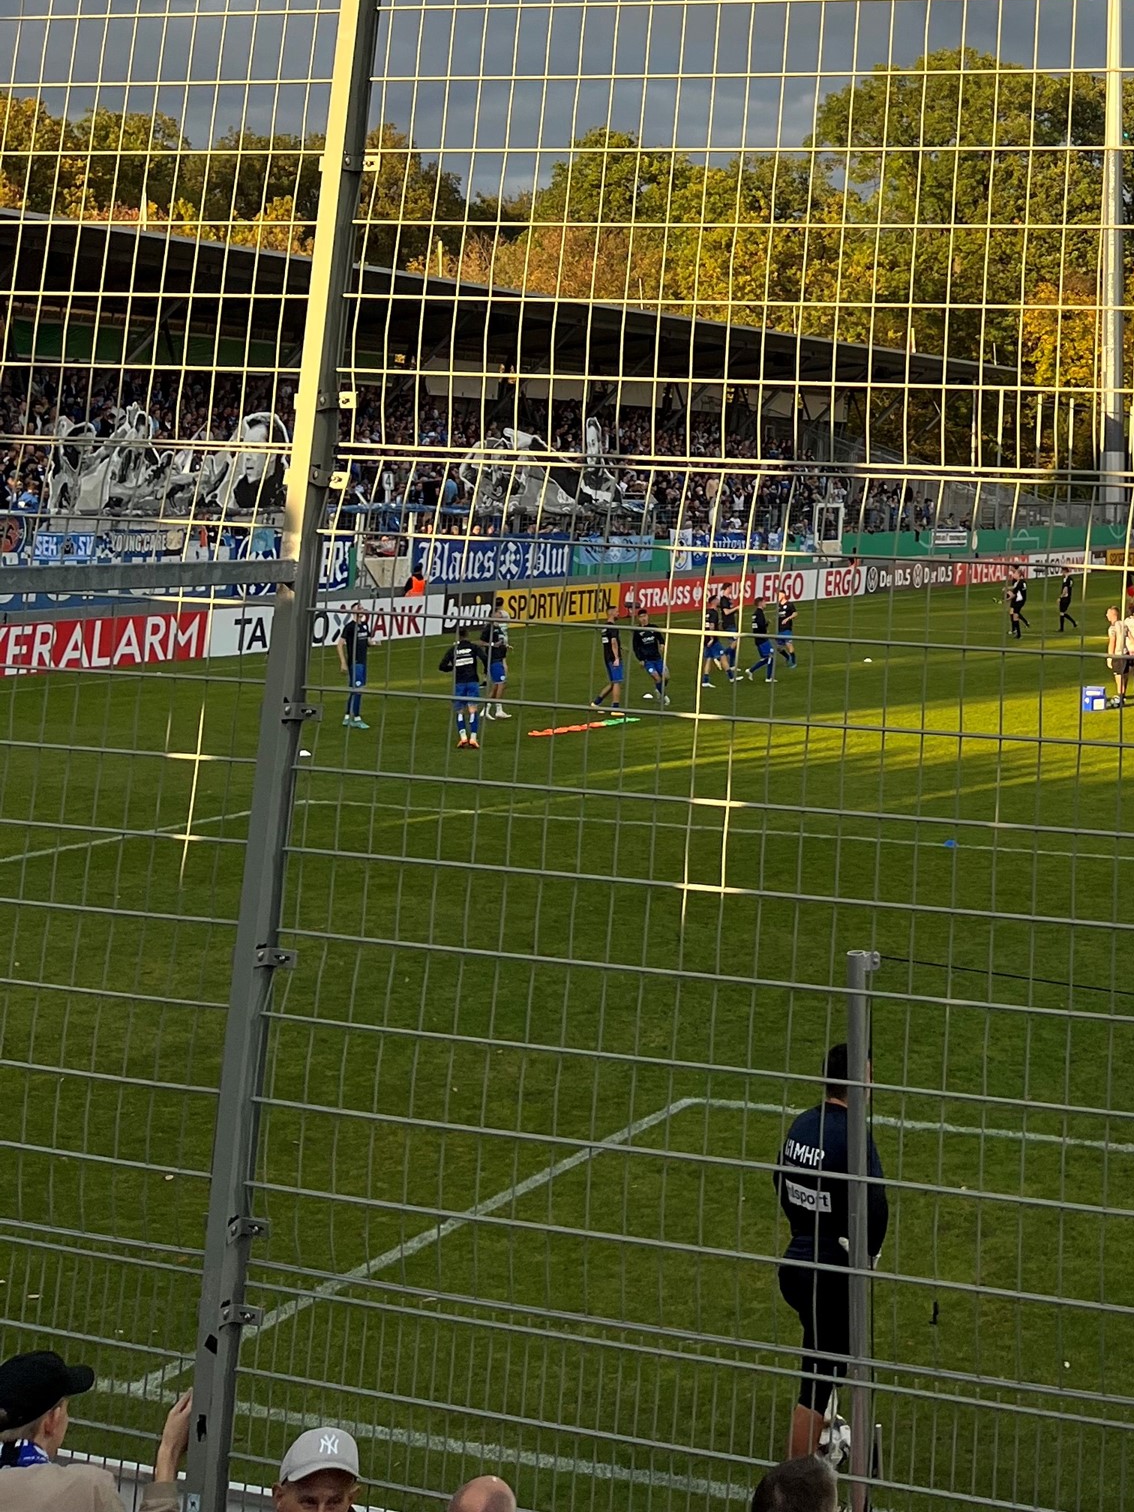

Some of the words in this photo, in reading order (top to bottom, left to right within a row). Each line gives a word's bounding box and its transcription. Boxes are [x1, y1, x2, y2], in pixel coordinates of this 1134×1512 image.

[384, 473, 392, 488] 4
[418, 541, 497, 583] Blaues
[525, 540, 569, 577] Blut
[937, 565, 952, 583] ID.5
[762, 572, 804, 602] ERGO
[825, 568, 861, 597] ERGO
[894, 567, 911, 587] ID.5
[508, 588, 611, 620] SPORTWETTEN
[638, 585, 690, 608] STRAUSS
[444, 595, 492, 629] bwin
